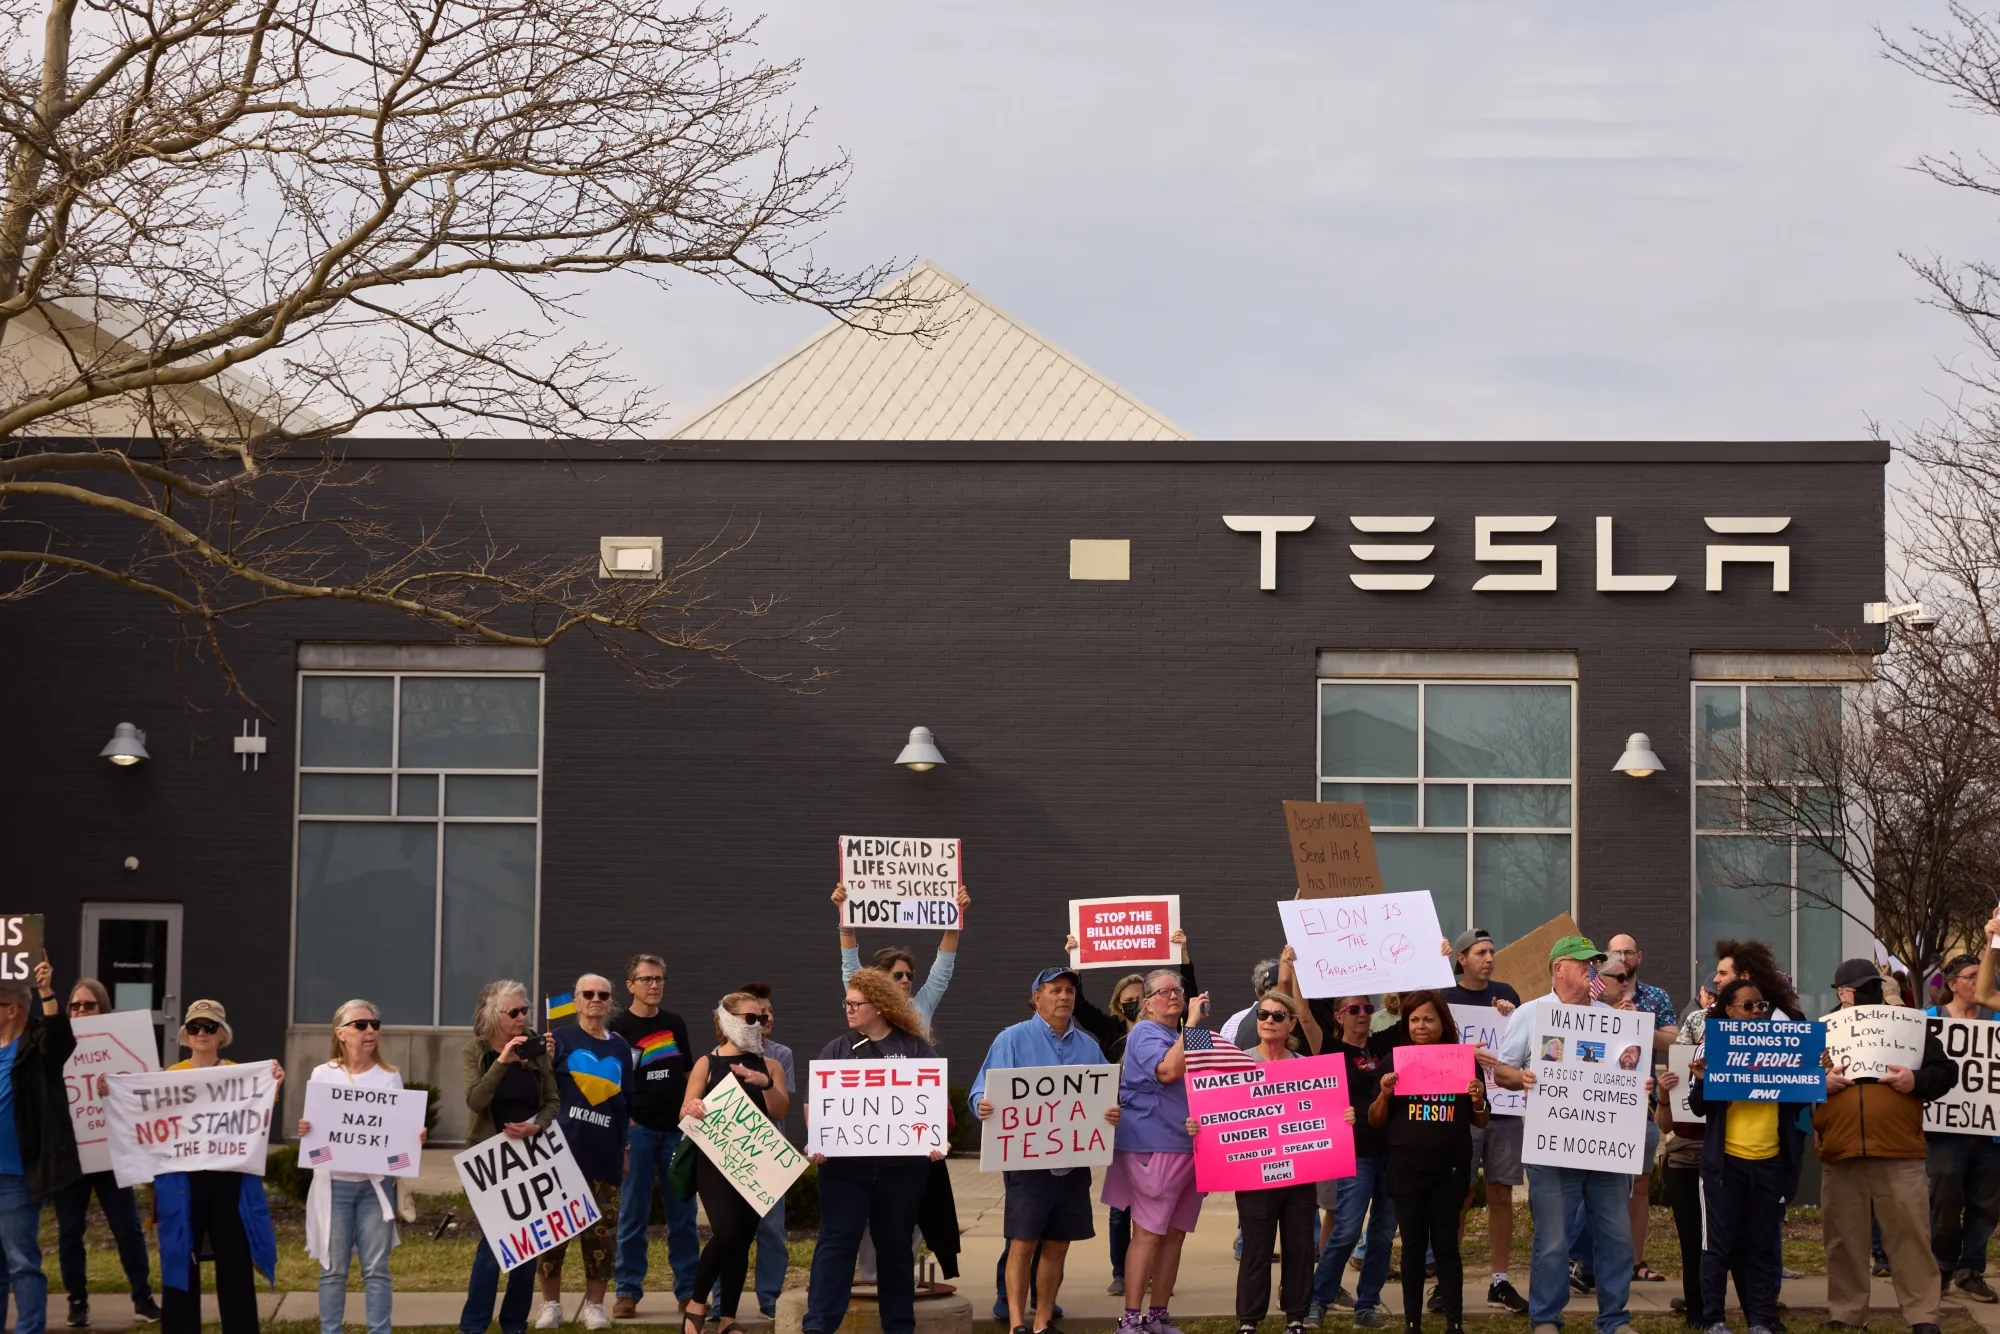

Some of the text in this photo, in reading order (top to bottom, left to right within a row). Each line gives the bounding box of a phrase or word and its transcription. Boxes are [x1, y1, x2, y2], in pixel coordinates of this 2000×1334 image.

[1222, 515, 1791, 592] TESLA
[847, 839, 956, 859] MEDICAID IS
[1300, 842, 1326, 864] Send
[1330, 841, 1350, 861] Him
[853, 860, 948, 877] LIFESAVING
[848, 880, 957, 898] TO THE SICKEST
[1306, 870, 1325, 890] his
[849, 900, 958, 925] MOST IN NEED
[1095, 911, 1152, 924] STOP THE
[1300, 902, 1401, 935] ELON IS
[1086, 924, 1162, 938] BILLIONAIRE
[1337, 934, 1368, 948] THE
[1093, 938, 1156, 951] TAKEOVER
[1551, 1009, 1621, 1035] WANTED
[1718, 1021, 1812, 1034] THE POST OFFICE
[1729, 1036, 1800, 1047] BELONGS TO
[73, 1050, 112, 1067] MUSK
[1726, 1051, 1803, 1068] THE PEOPLE
[815, 1068, 940, 1089] TESLA
[1011, 1069, 1109, 1100] DON'T
[1193, 1070, 1265, 1090] WAKE UP
[1252, 1077, 1337, 1098] AMERICA!!!
[1544, 1067, 1637, 1087] FASCIST OLIGARCHS
[1709, 1073, 1820, 1085] NOT THE BILLIONAIRES
[132, 1076, 264, 1112] THIS WILL
[331, 1087, 398, 1106] DEPORT
[1539, 1084, 1638, 1106] FOR CRIMES
[1748, 1089, 1781, 1100] APWU
[823, 1094, 930, 1116] FUNDS
[1002, 1100, 1087, 1130] BUY A
[1200, 1100, 1312, 1126] DEMOCRACY IS
[1408, 1103, 1455, 1122] PERSON
[1548, 1106, 1617, 1124] AGAINST
[135, 1108, 270, 1145] NOT STAND!
[342, 1112, 382, 1128] NAZI
[568, 1106, 612, 1128] UKRAINE
[711, 1086, 801, 1169] MUSKRATS
[328, 1131, 389, 1148] MUSK!
[704, 1108, 763, 1158] ARE AN
[1221, 1119, 1325, 1143] UNDER SEIGE!
[208, 1141, 247, 1156] DUDE
[695, 1119, 758, 1177] INVASIVE
[997, 1128, 1106, 1162] TESLA
[1227, 1140, 1330, 1162] STAND UP SPEAK UP
[463, 1129, 564, 1193] WAKE
[1263, 1161, 1291, 1171] FIGHT
[718, 1155, 775, 1206] SPECIES
[1264, 1172, 1292, 1182] BACK!
[501, 1166, 568, 1221] UP!
[498, 1193, 598, 1269] AMERICA
